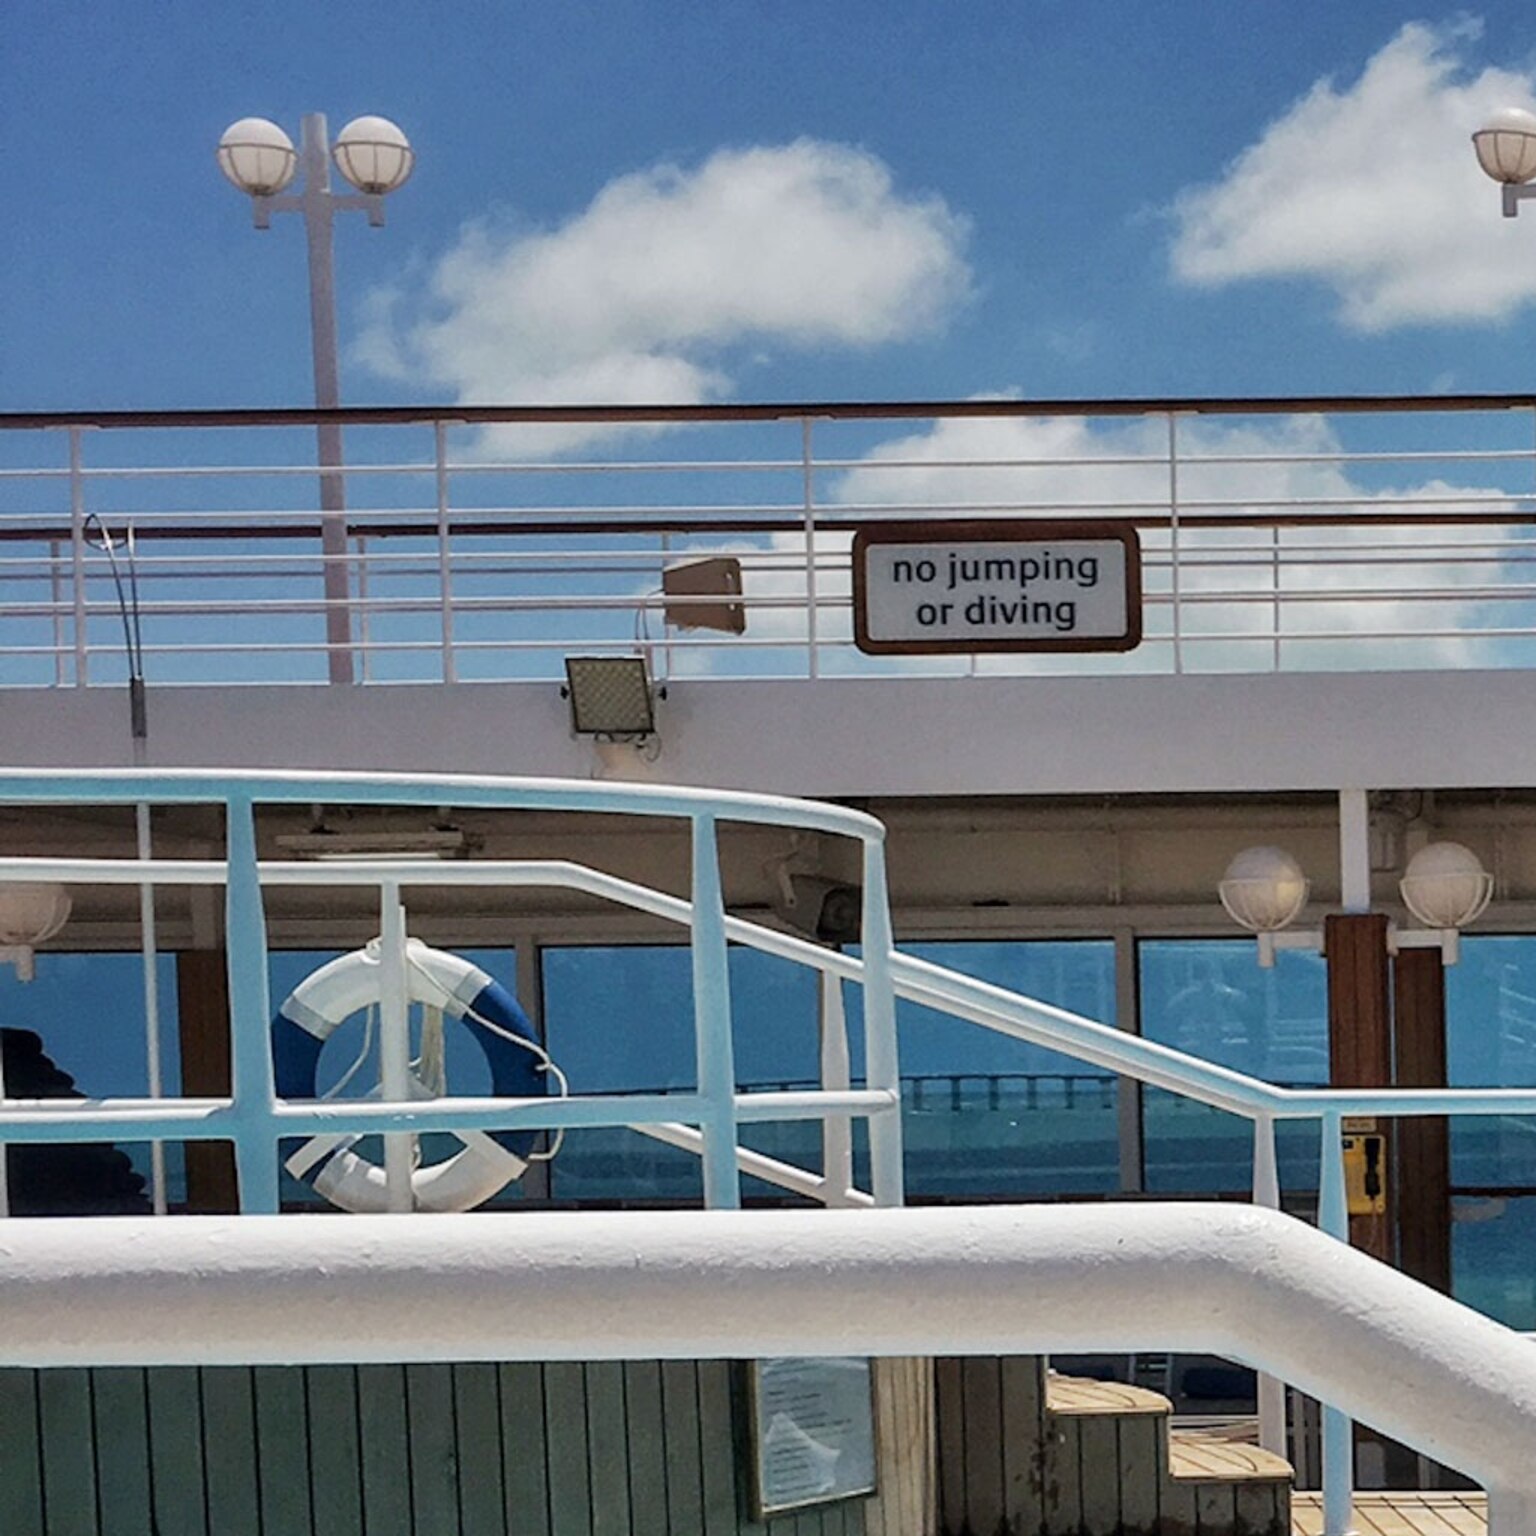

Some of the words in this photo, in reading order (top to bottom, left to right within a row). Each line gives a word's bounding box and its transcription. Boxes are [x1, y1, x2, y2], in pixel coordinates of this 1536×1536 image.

[892, 559, 936, 583] no
[947, 551, 1098, 590] jumping
[916, 601, 953, 626] or
[964, 595, 1076, 631] diving
